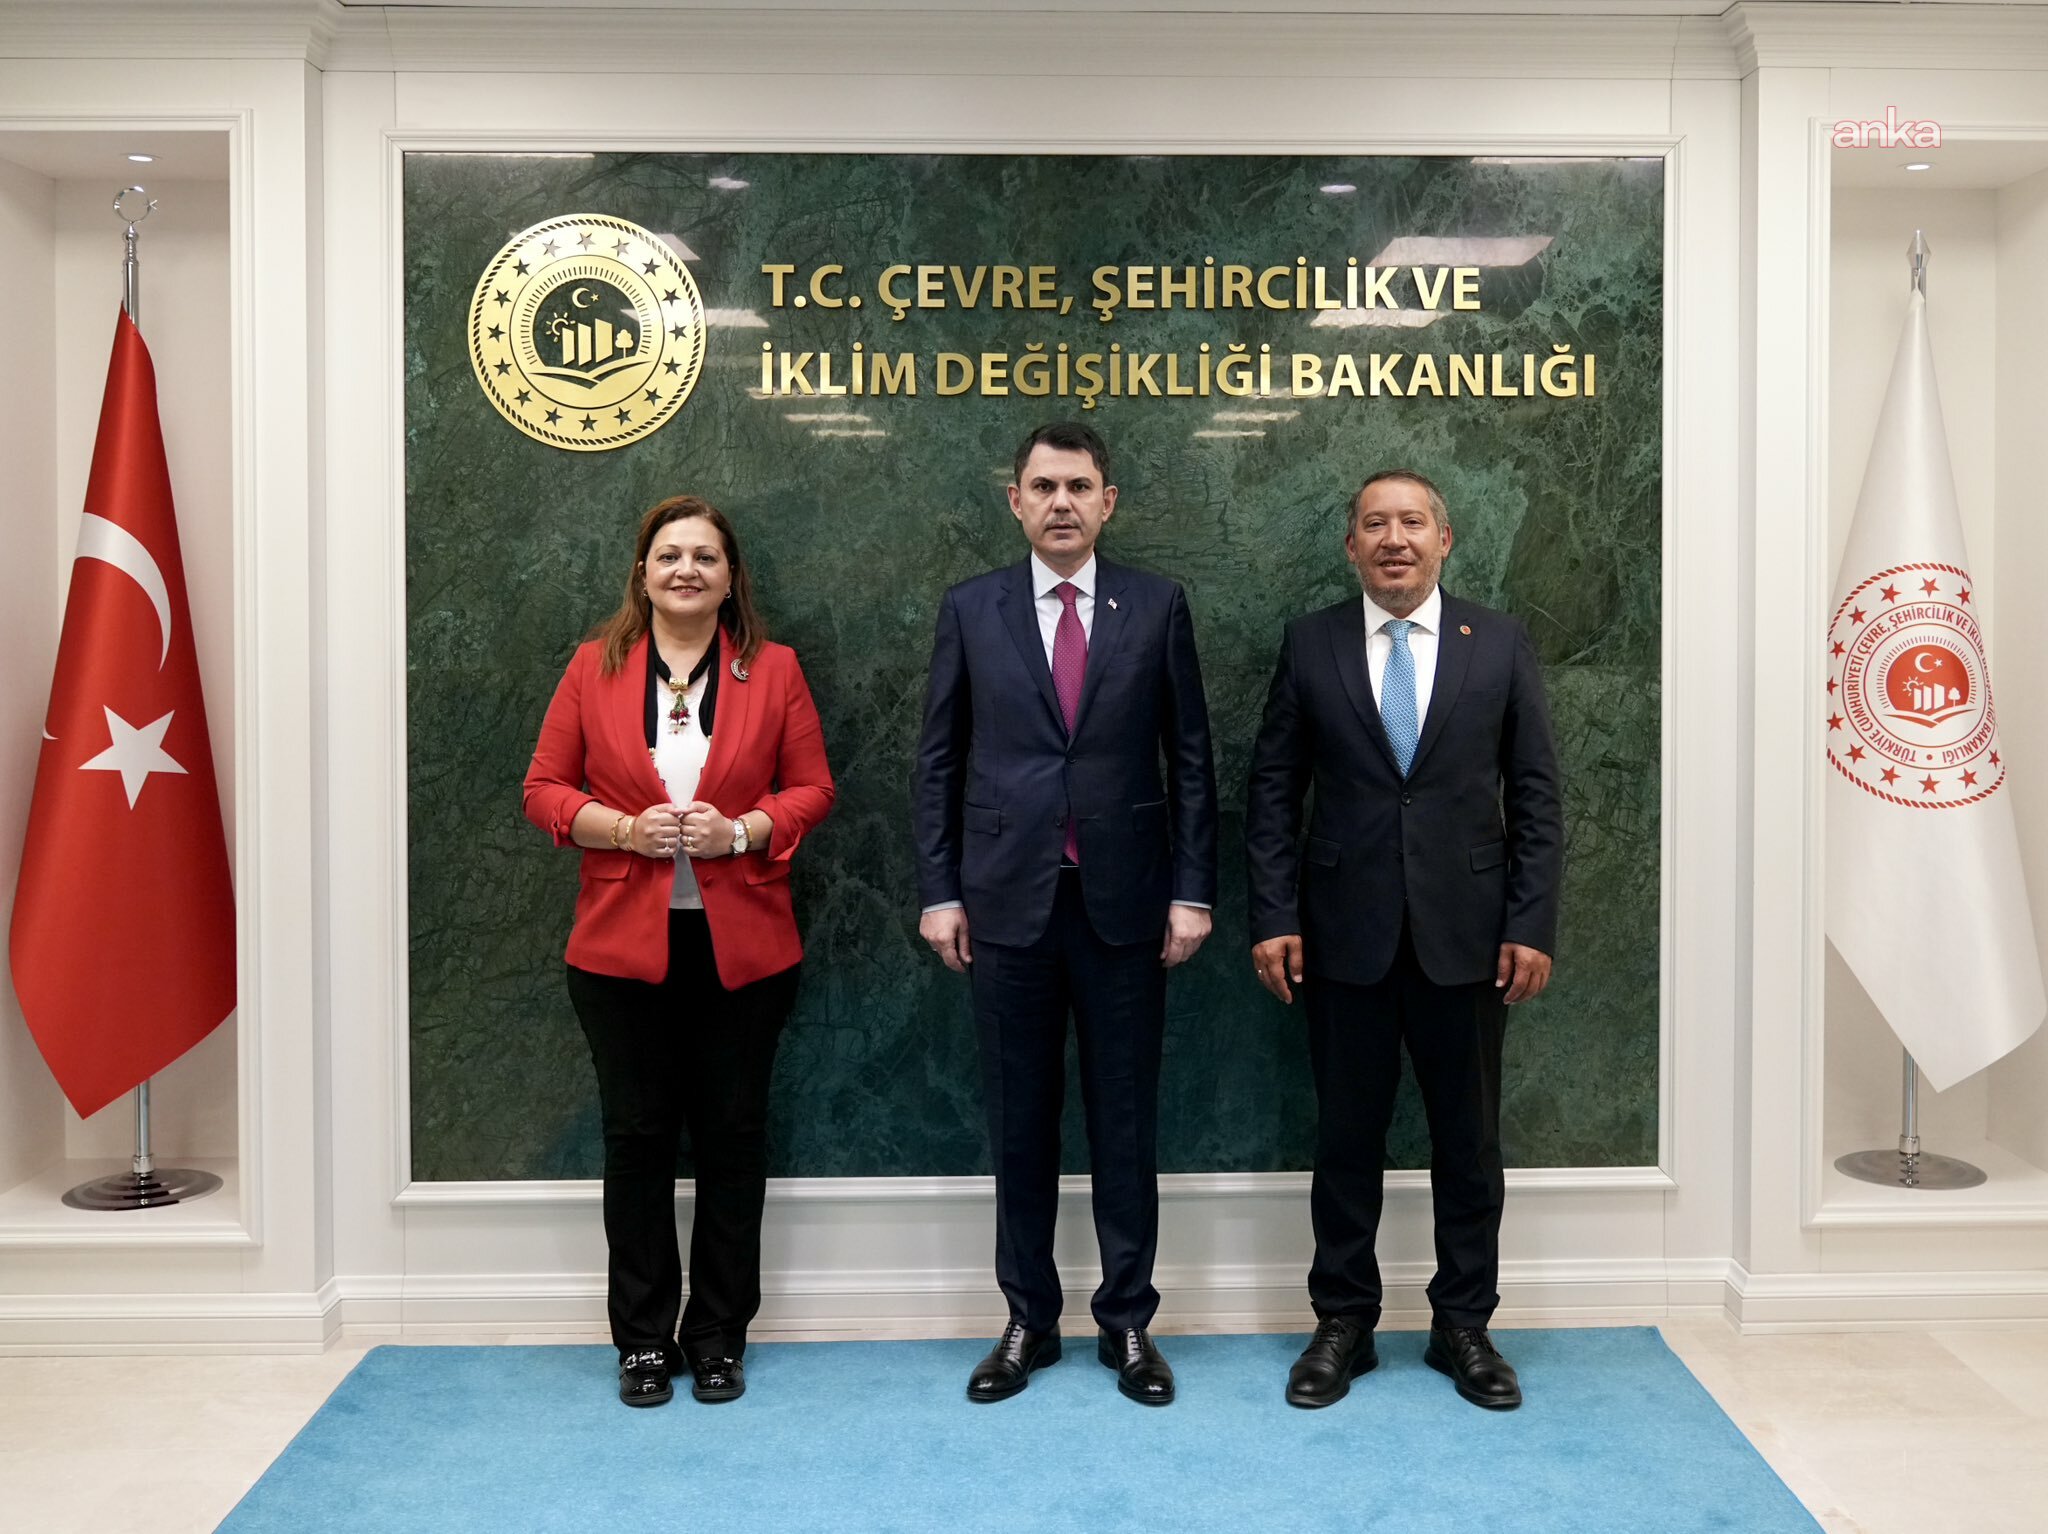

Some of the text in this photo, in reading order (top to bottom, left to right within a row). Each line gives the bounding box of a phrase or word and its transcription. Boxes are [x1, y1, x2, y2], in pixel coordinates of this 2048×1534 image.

[761, 256, 1481, 321] T.C. ÇEVRE, ŞEHİRCİLİK VE
[761, 341, 1596, 409] İKLİM DEĞİŞİKLİĞİ BAKANLIĞI
[1888, 604, 1955, 629] ŞEHİRCİLİK
[1955, 614, 1969, 630] VE
[1857, 622, 1891, 655] ÇEVRE,
[1845, 654, 1874, 732] CUMHURİYETİ
[1869, 729, 1916, 762] TÜRKİYE
[1942, 722, 1992, 765] BAKANLIĞI
